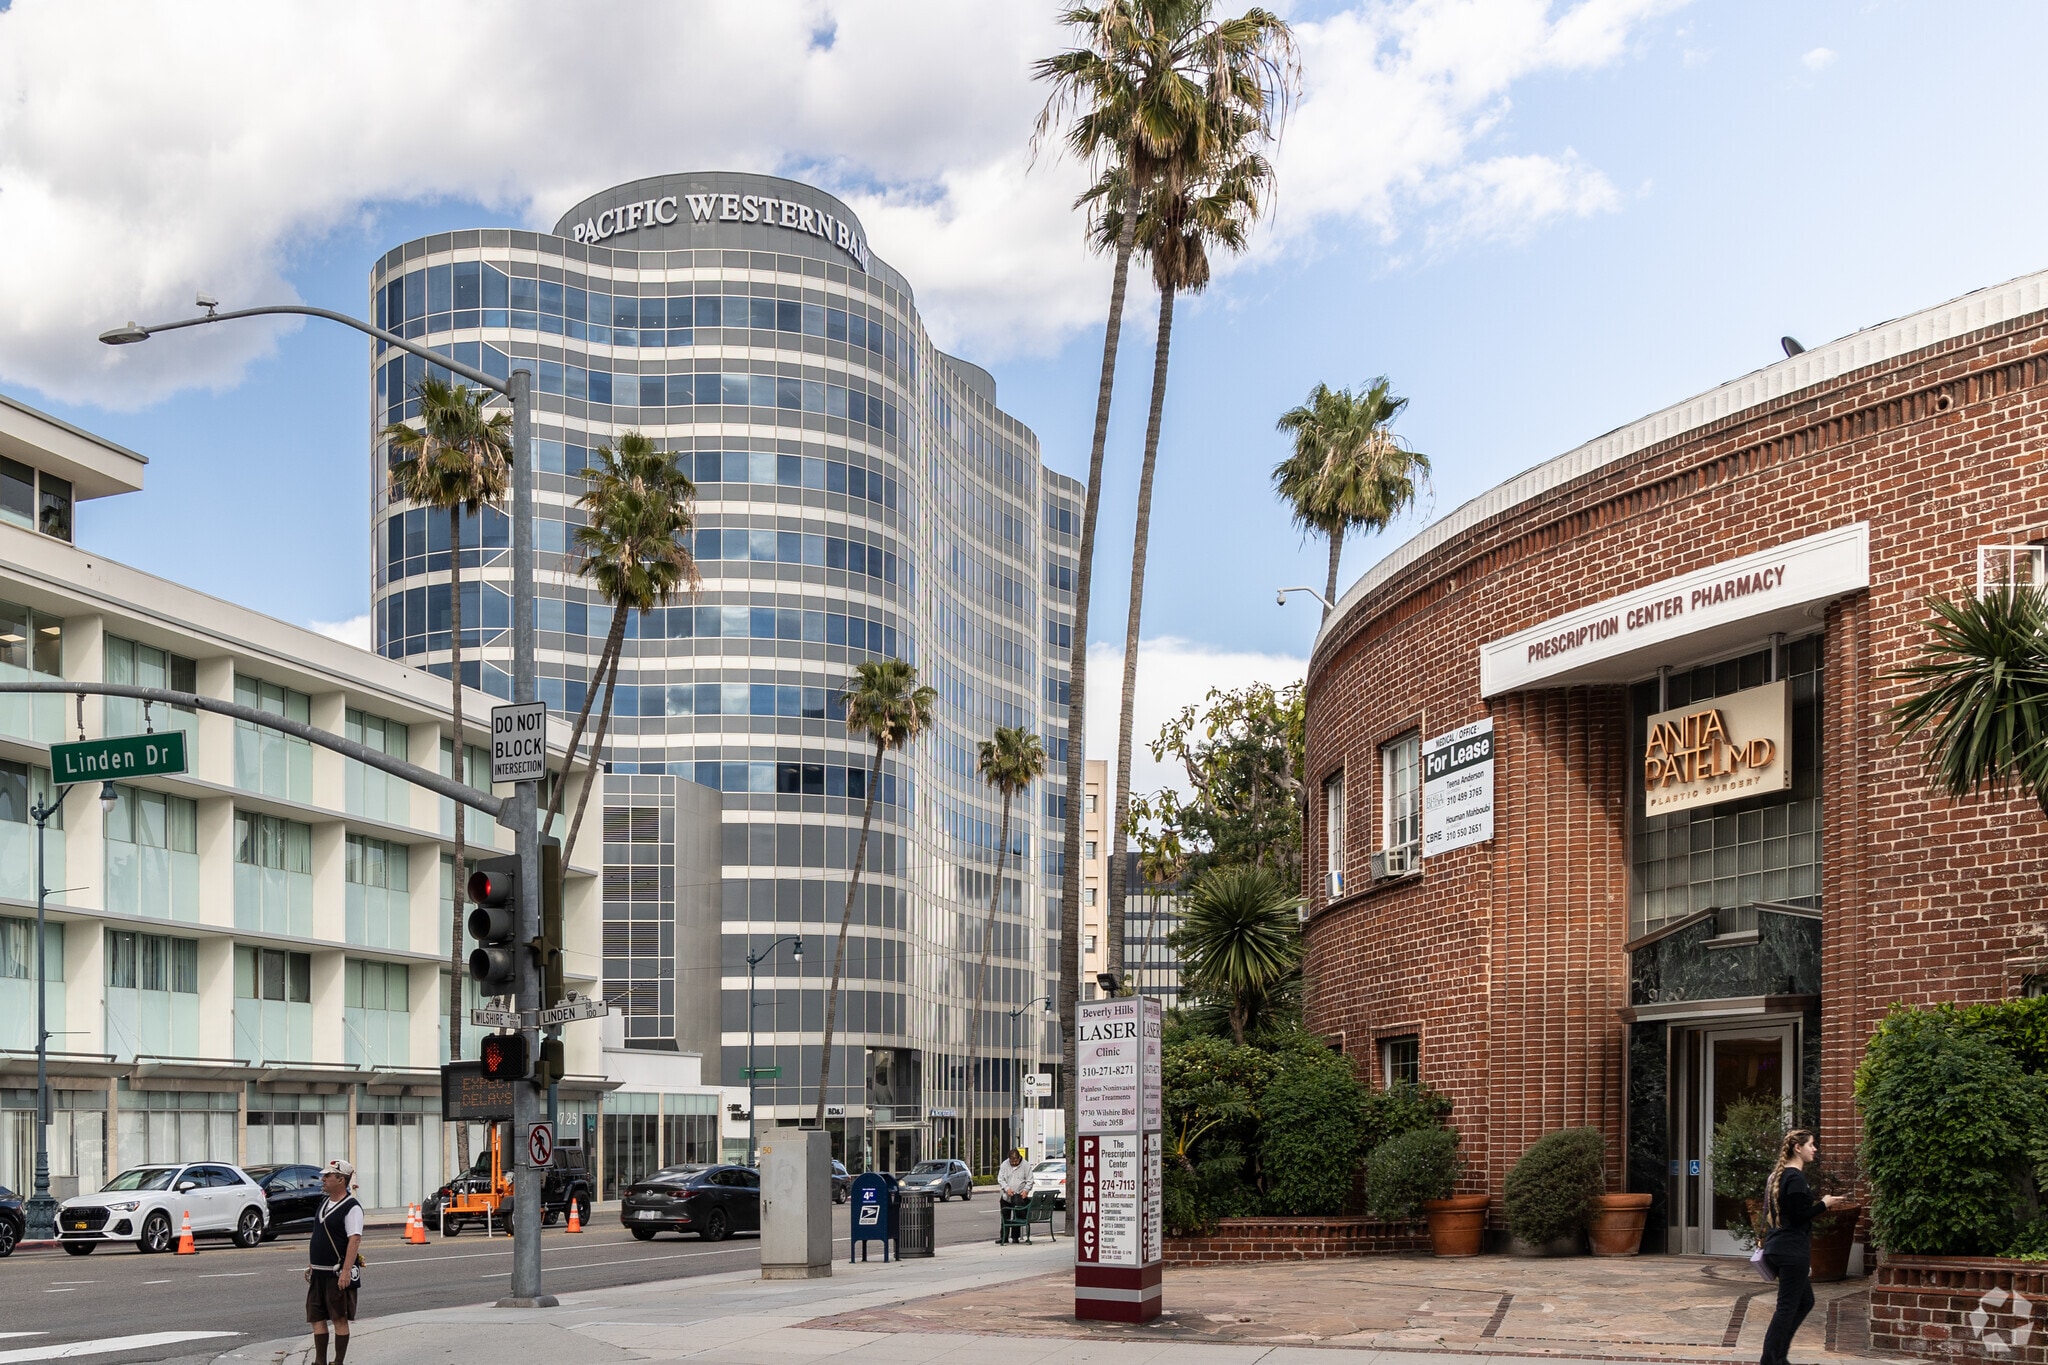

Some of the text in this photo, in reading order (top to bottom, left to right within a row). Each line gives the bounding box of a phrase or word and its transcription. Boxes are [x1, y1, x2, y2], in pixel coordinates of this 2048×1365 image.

[573, 196, 678, 244] PACIFIC
[685, 193, 834, 240] WESTERN
[1527, 565, 1786, 663] PRESCRIPTION CENTER PHARMACY
[495, 713, 542, 734] DO NOT
[1435, 732, 1455, 748] MEDICAL
[1459, 725, 1477, 739] OFFICE
[1645, 709, 1731, 758] ANITA
[495, 737, 542, 758] BLOCK
[65, 744, 168, 774] Linden Dr
[1427, 738, 1490, 776] For Lease
[1645, 738, 1775, 791] PATEL MD
[495, 760, 542, 775] INTERSECTION
[1446, 770, 1484, 790] Teena Anderson
[1446, 795, 1457, 806] 310
[1458, 791, 1468, 802] 499
[1468, 786, 1483, 799] 3765
[1650, 776, 1761, 807] PLASTIC SURGERY
[1445, 802, 1490, 824] Houman Mahboubi
[1426, 830, 1442, 844] CBRE
[1446, 831, 1456, 841] 310
[1457, 827, 1468, 838] 550
[1468, 823, 1482, 835] 2651
[476, 1012, 504, 1026] WILSHIRE
[542, 1008, 576, 1024] LINDEN
[586, 1009, 597, 1018] 100
[1082, 1005, 1134, 1018] Beverly Hills
[1079, 1022, 1137, 1041] LASER
[1096, 1046, 1120, 1057] Clinic
[1082, 1065, 1134, 1077] 310-271-8271
[462, 1093, 513, 1107] DELAYS
[1101, 1093, 1131, 1101] Treatments
[557, 1111, 577, 1126] 725
[827, 1107, 844, 1115] BD&J
[762, 1146, 772, 1154] 50
[1113, 1140, 1124, 1148] The
[1101, 1149, 1135, 1159] Prescription
[1108, 1160, 1128, 1168] Center
[1101, 1180, 1135, 1191] 274-7113
[1082, 1140, 1096, 1259] PHARMACY
